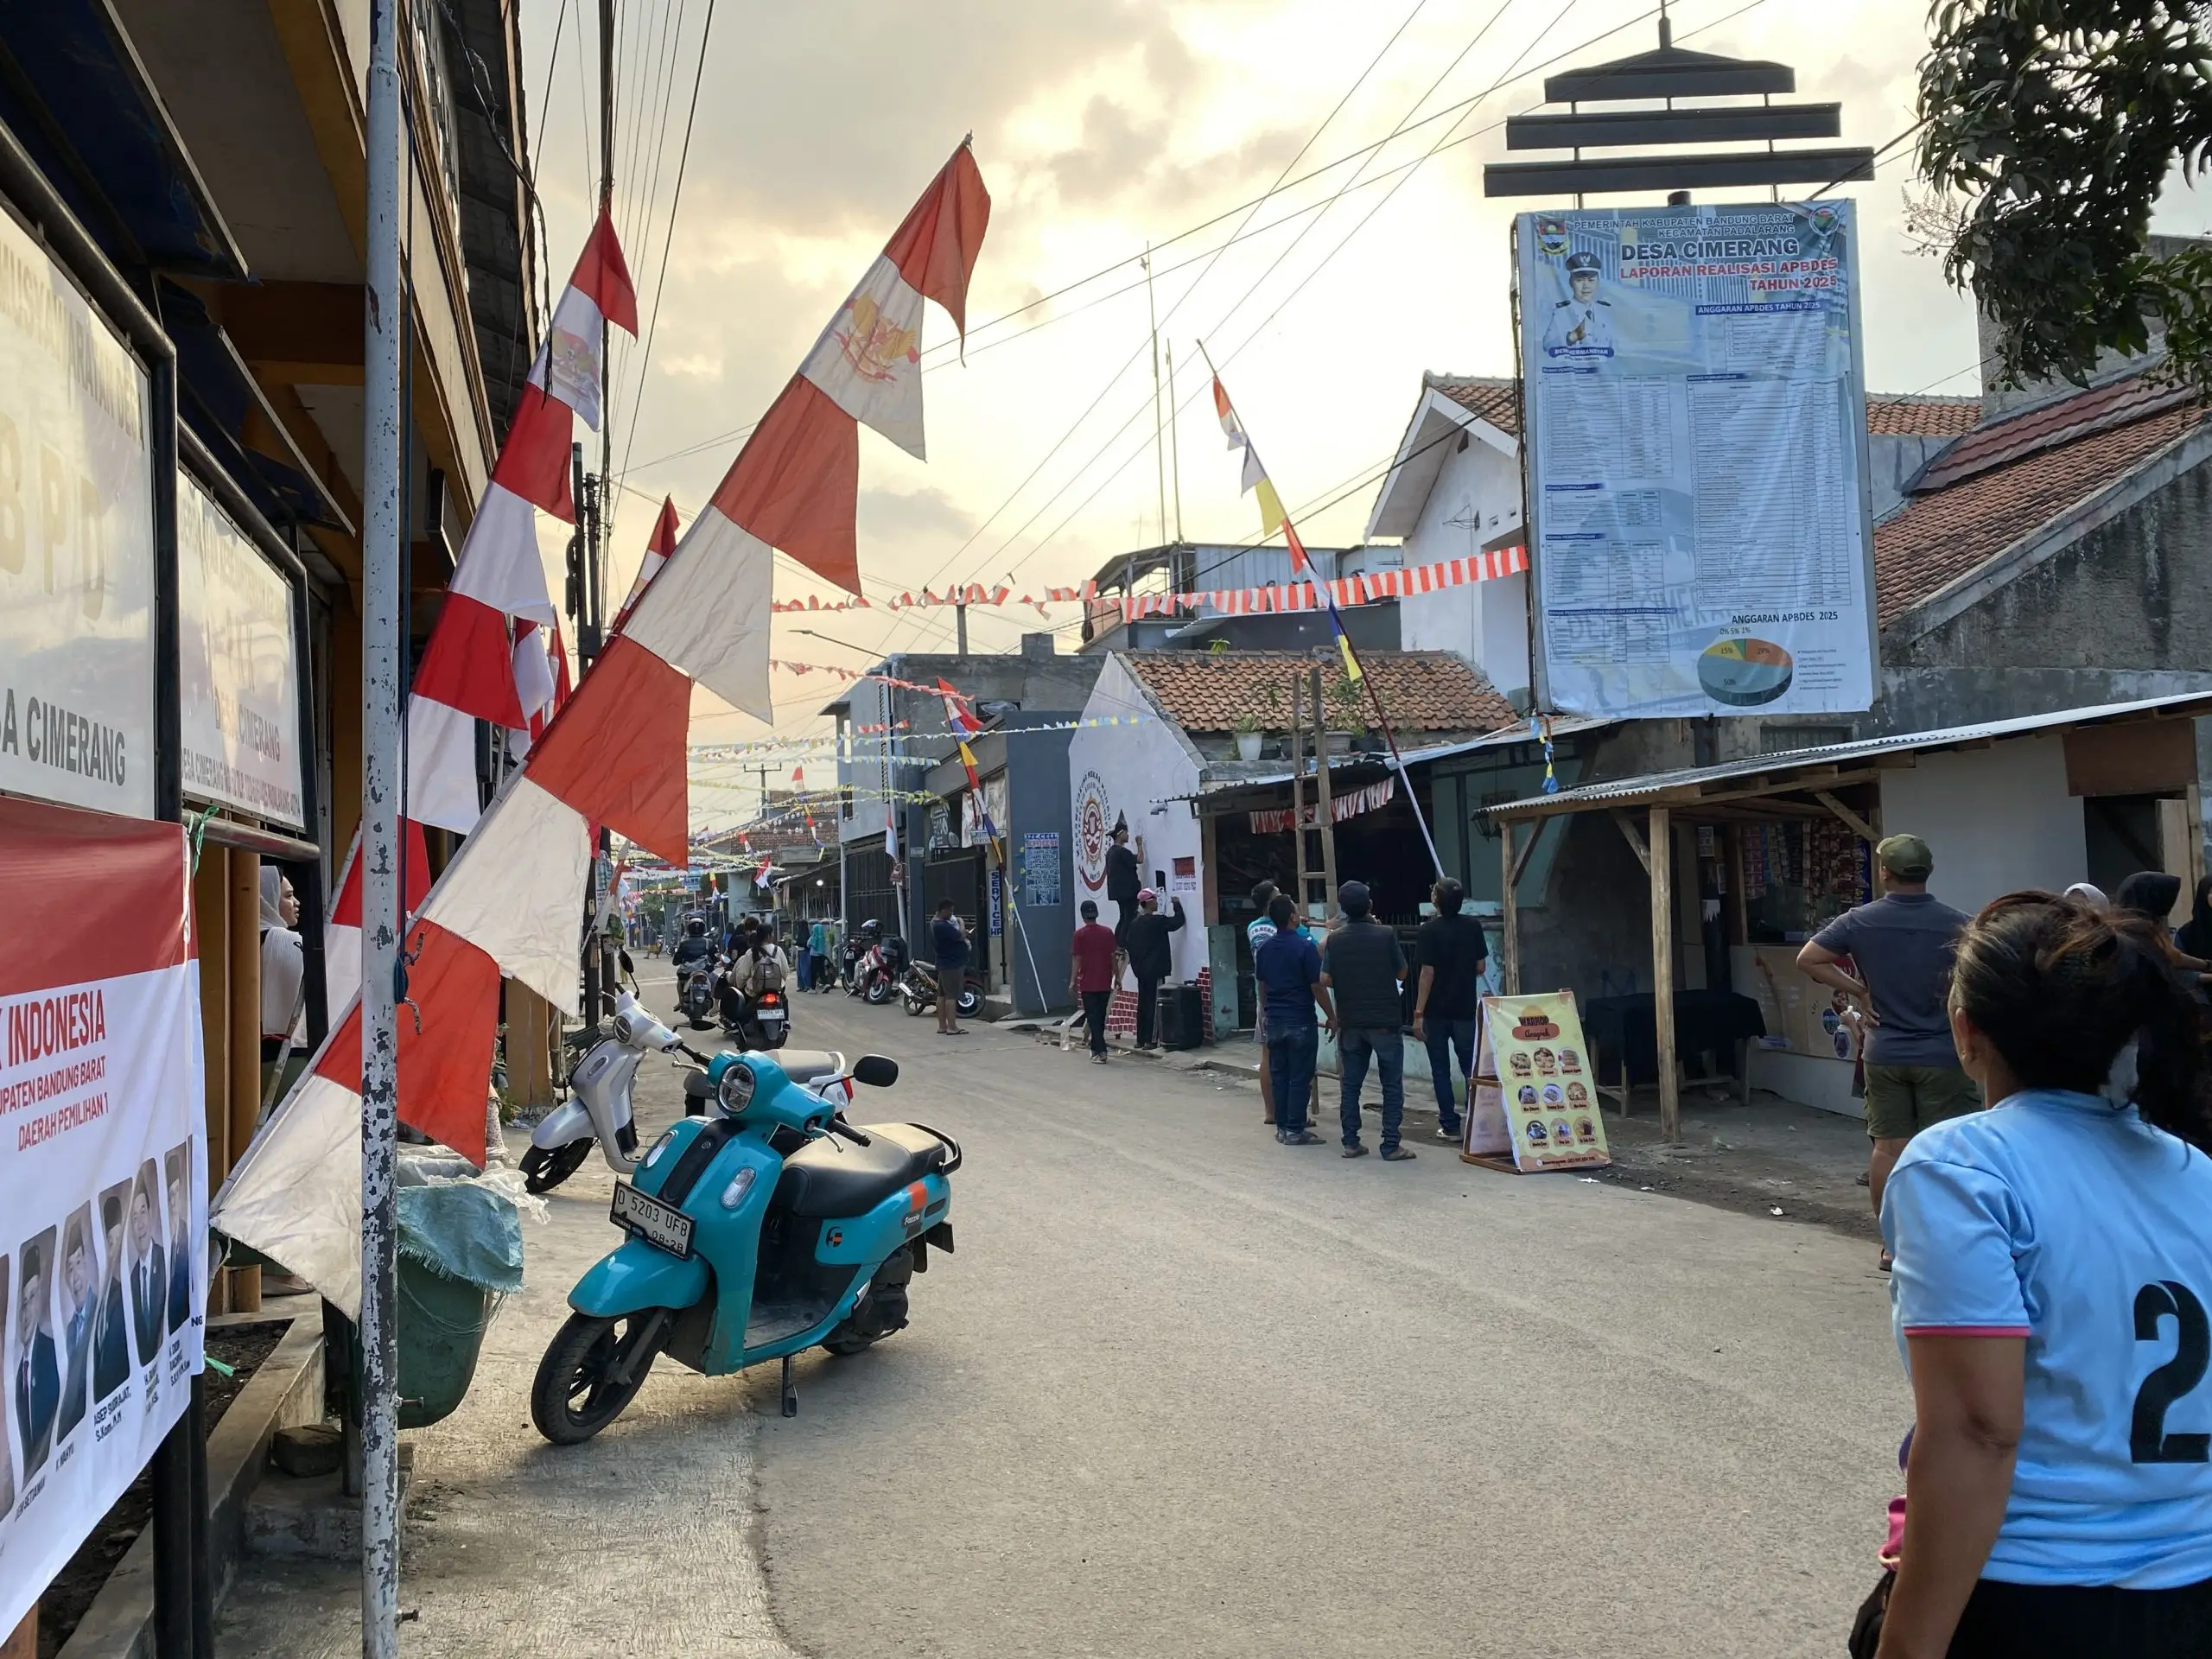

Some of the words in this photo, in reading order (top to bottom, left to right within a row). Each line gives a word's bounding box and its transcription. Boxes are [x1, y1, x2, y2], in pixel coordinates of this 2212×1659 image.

[1574, 218, 1640, 230] PEMERINTAH
[1642, 217, 1703, 228] KABUPATEN
[1706, 216, 1759, 226] BANDUNG
[1761, 213, 1794, 224] BARAT
[1658, 226, 1722, 238] KECAMATAN
[1723, 224, 1795, 235] PADALARANG
[1621, 242, 1680, 261] DESA
[1683, 238, 1799, 258] CIMERANG
[1620, 264, 1695, 279] LAPORAN
[1696, 261, 1776, 276] REALISASI
[1779, 257, 1838, 274] APBDES
[1750, 278, 1802, 292] TAHUN
[1803, 275, 1837, 289] 2025
[1698, 305, 1743, 314] ANGGARAN
[1744, 303, 1773, 312] APBDES
[1775, 303, 1802, 311] TAHUN
[1732, 614, 1780, 624] ANGGARAN
[1782, 612, 1815, 623] APBDES
[1819, 611, 1838, 621] 2025
[26, 696, 125, 786] CIMERANG
[239, 702, 280, 763] CIMERANG
[991, 872, 1001, 927] SERVICE
[8, 989, 106, 1068] INDONESIA
[38, 1065, 80, 1102] BANDUNG
[80, 1056, 106, 1086] BARAT
[18, 1112, 57, 1151] DAERAH
[58, 1094, 103, 1134] PEMILIHAN
[104, 1092, 108, 1113] 1
[618, 1190, 625, 1205] D
[631, 1195, 660, 1223] 5203
[2129, 1279, 2211, 1464] 2
[94, 1406, 107, 1427] ASEP
